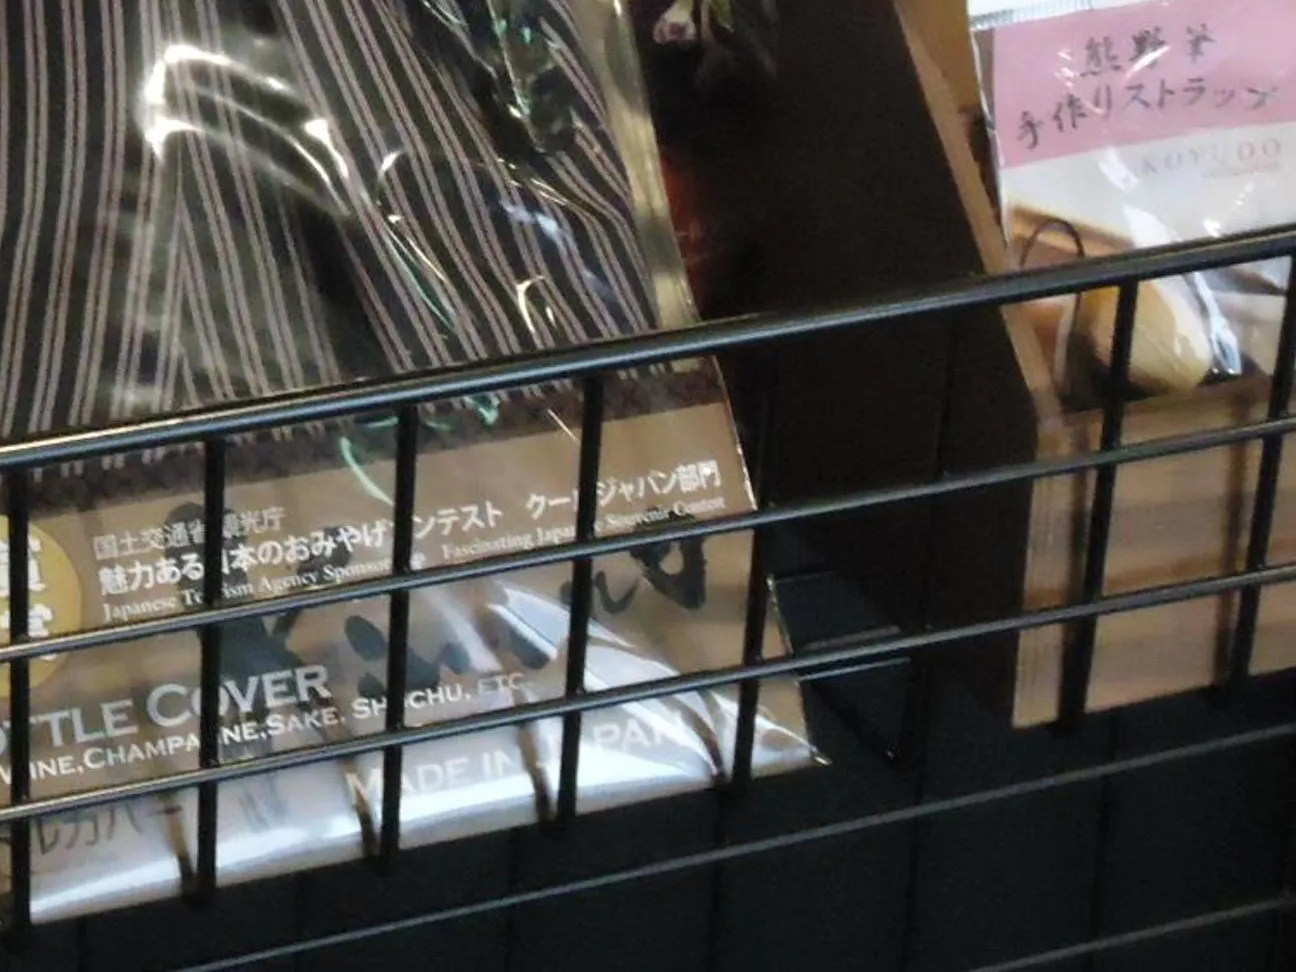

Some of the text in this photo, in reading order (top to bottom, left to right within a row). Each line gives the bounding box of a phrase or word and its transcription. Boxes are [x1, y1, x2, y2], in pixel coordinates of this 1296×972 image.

[525, 459, 723, 520] クージャパン部門
